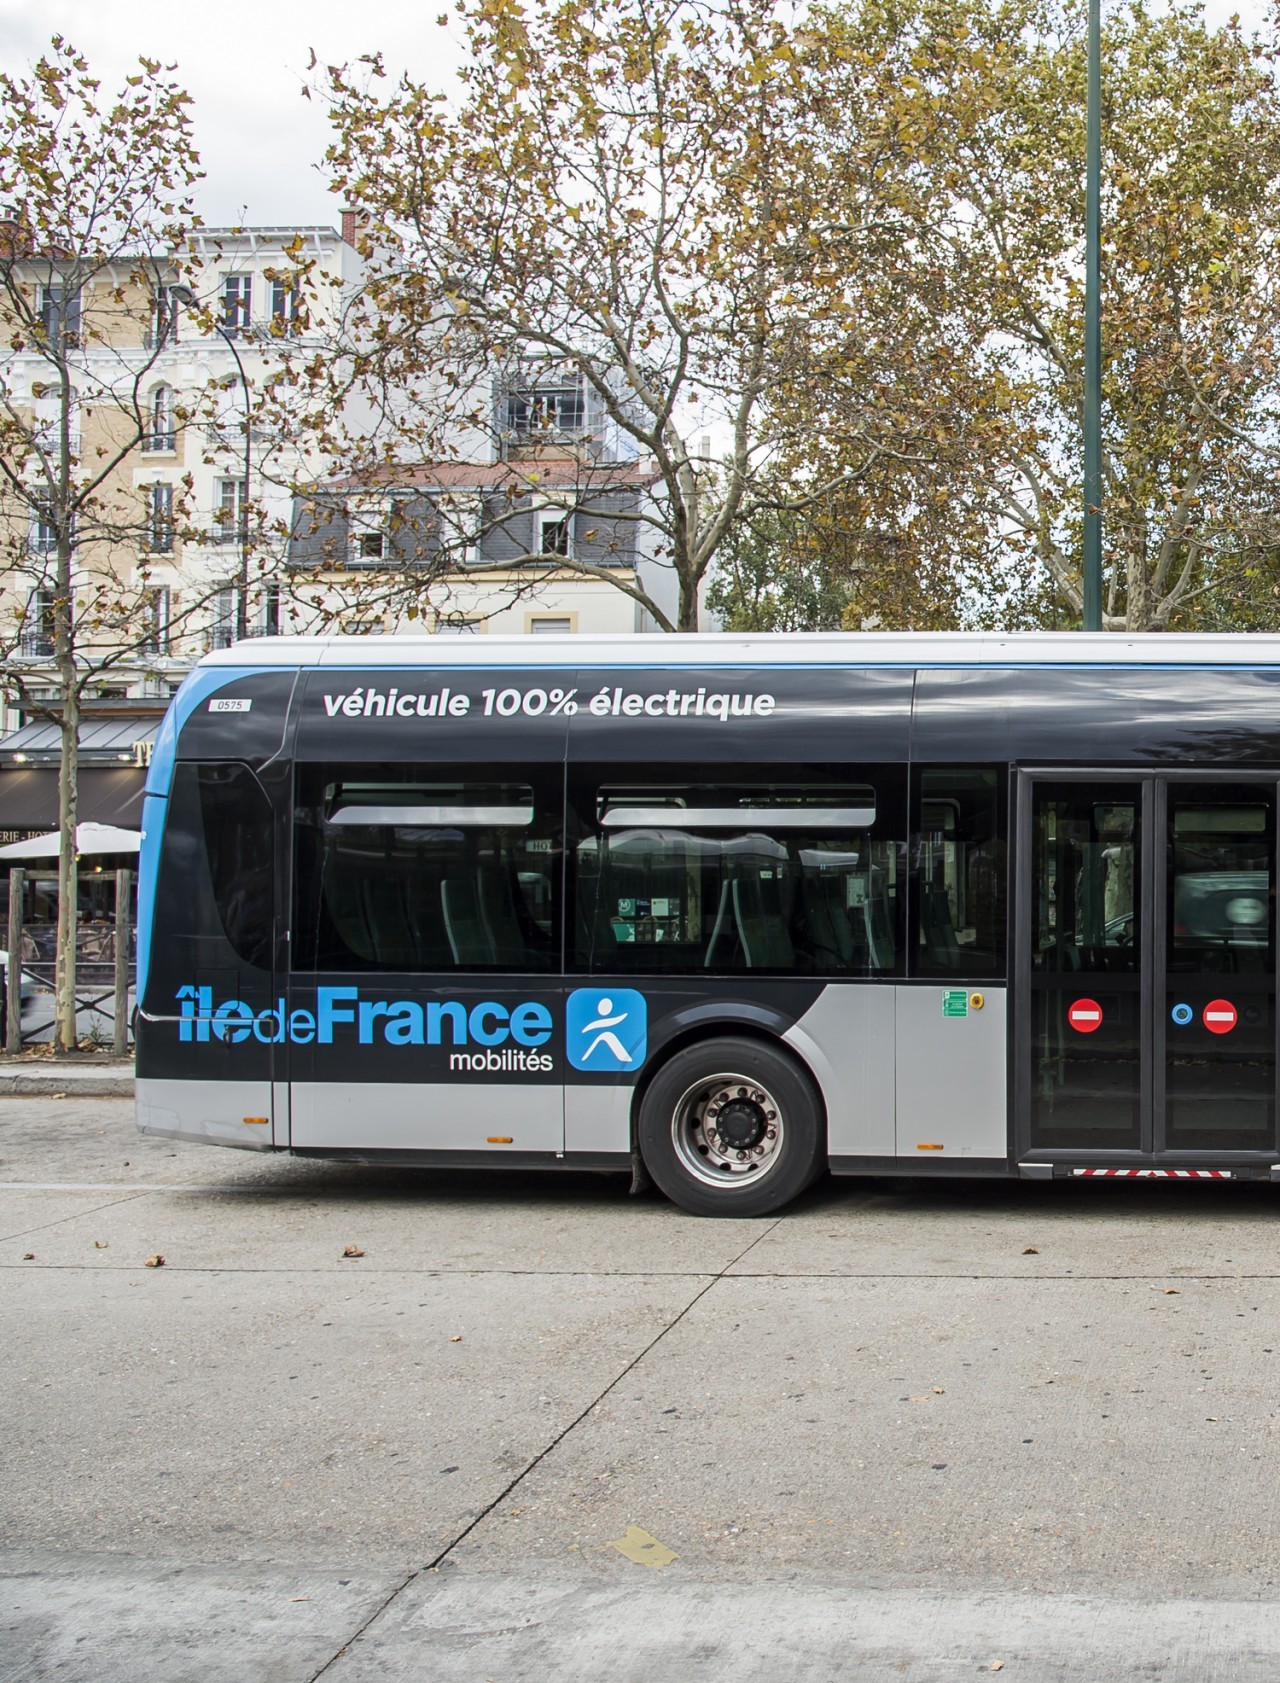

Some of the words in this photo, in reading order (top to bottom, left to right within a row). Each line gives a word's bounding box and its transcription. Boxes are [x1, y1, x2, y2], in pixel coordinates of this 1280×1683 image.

[217, 700, 242, 710] 0575
[323, 687, 470, 717] véhicule
[481, 688, 581, 717] 100%
[587, 686, 777, 722] électrique
[450, 1047, 554, 1072] mobilités
